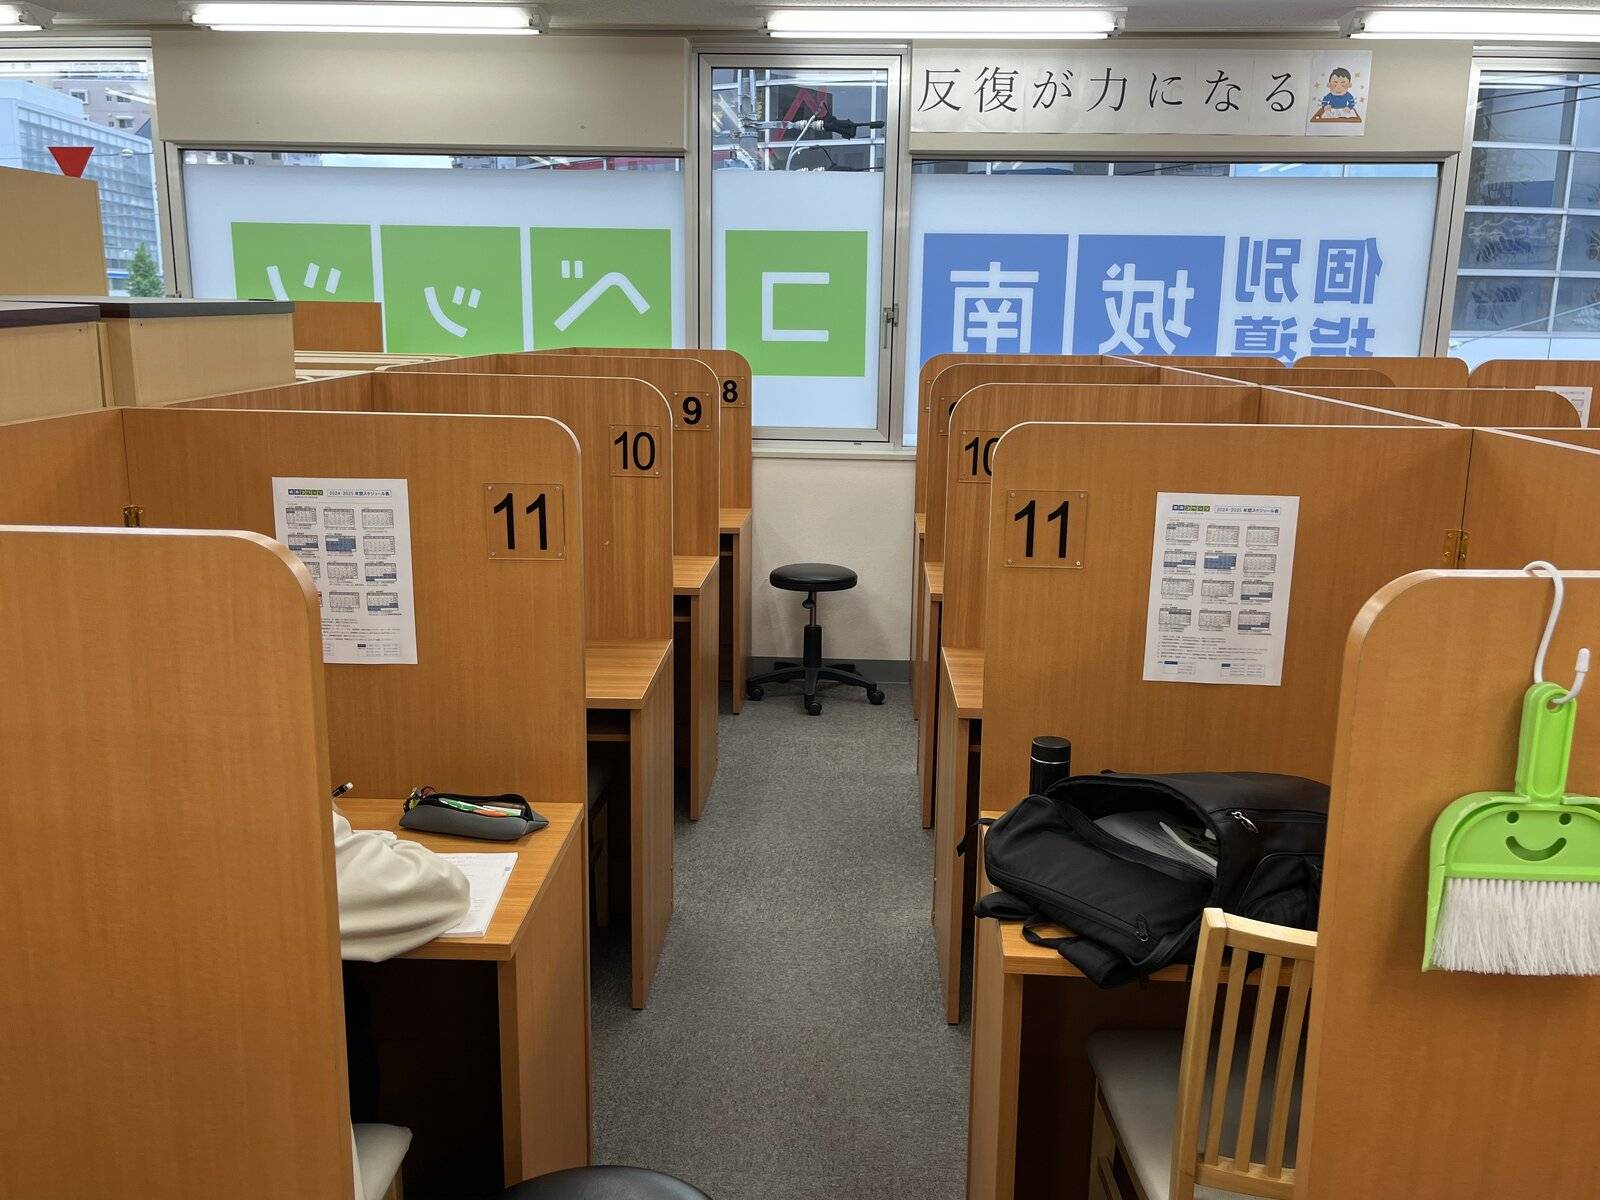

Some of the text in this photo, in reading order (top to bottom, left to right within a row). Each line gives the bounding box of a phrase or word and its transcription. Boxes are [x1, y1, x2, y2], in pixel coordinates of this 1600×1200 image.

[917, 67, 1295, 112] 反復が力になる
[682, 396, 702, 425] 9
[722, 379, 738, 403] 8
[614, 431, 656, 471] 10
[493, 492, 548, 551] 11
[1014, 499, 1069, 559] 11
